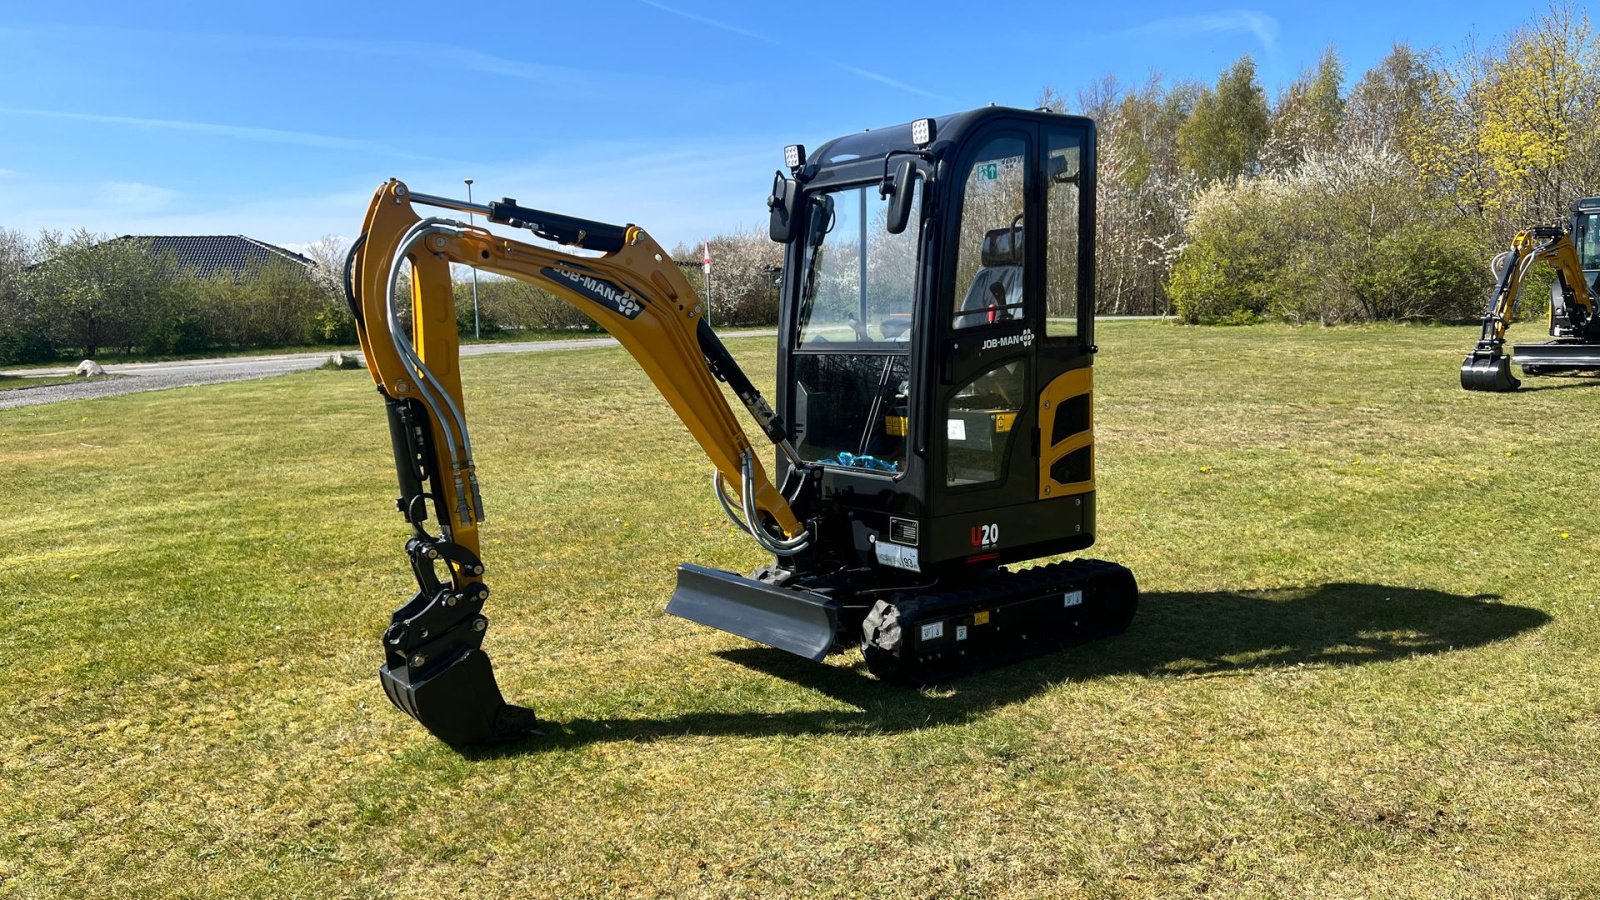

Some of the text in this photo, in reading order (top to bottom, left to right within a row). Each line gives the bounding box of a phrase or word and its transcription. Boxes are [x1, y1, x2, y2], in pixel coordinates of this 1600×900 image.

[982, 335, 1019, 350] JOB-MAN
[971, 523, 999, 546] U20
[903, 557, 914, 568] 93
